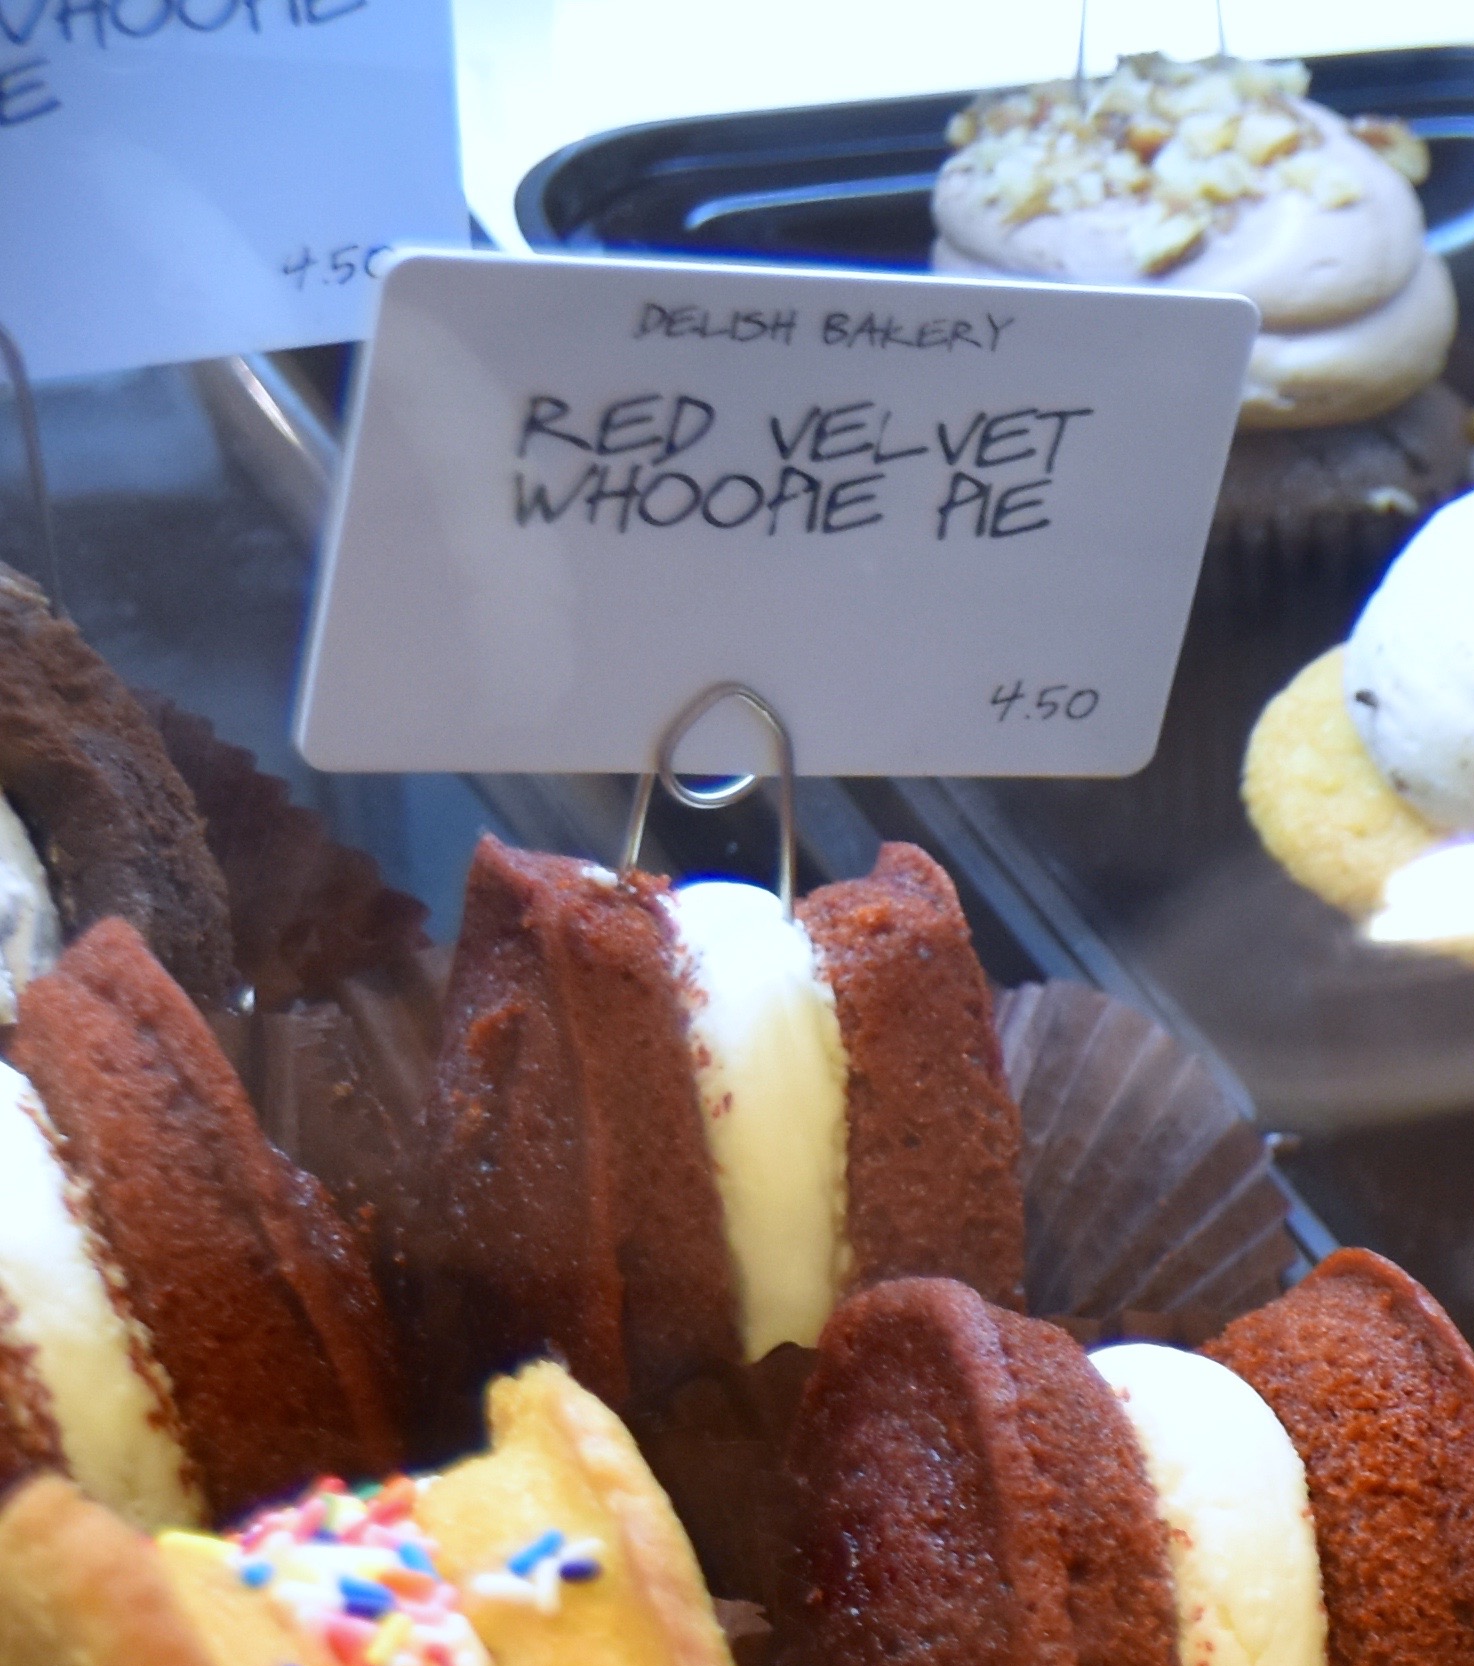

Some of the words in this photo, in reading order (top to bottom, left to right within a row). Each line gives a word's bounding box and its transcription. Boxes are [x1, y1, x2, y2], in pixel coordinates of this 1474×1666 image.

[632, 303, 799, 346] DELISH
[823, 311, 1016, 352] BAKERY
[517, 394, 716, 466] RED
[767, 401, 1095, 474] VELVET
[513, 463, 887, 537] WHOOPIE
[936, 471, 1054, 542] PIE
[988, 679, 1101, 724] 4.50
